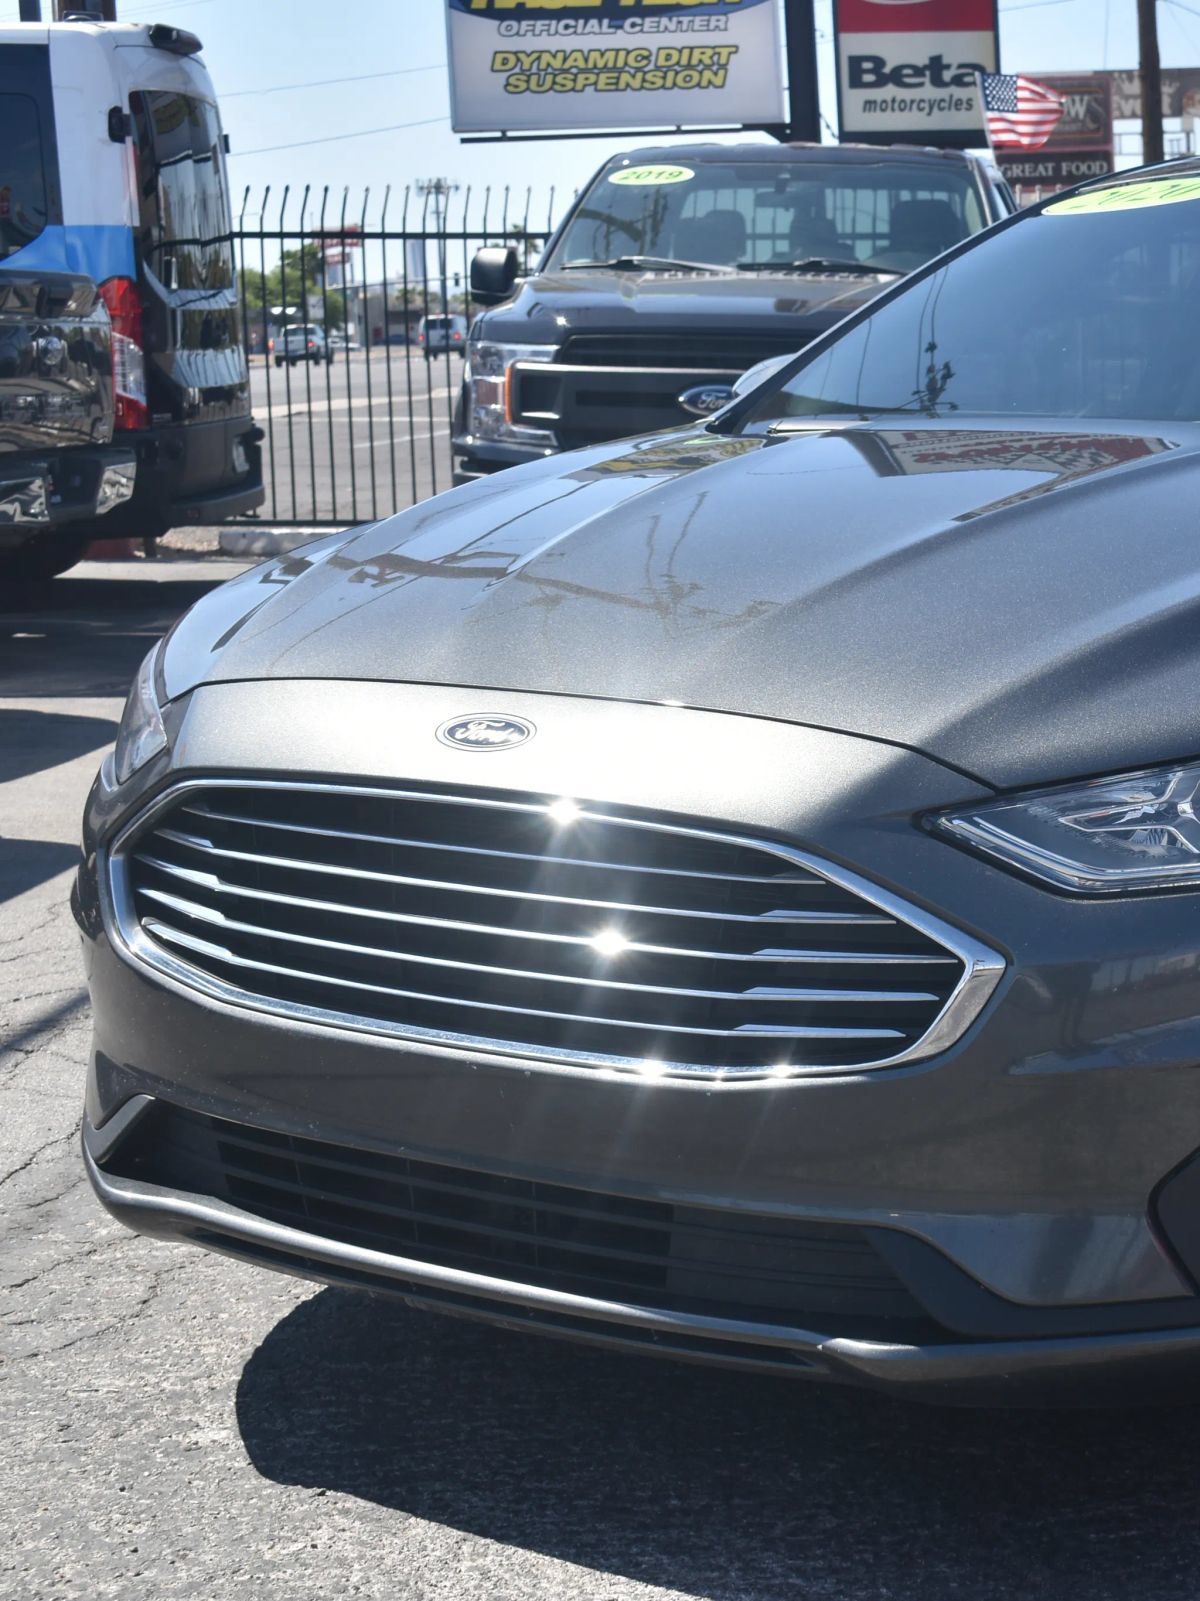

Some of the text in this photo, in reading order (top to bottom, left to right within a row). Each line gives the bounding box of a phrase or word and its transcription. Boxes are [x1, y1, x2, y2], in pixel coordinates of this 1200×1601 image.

[498, 15, 729, 37] OFFICIAL CENTER
[491, 45, 738, 73] DYNAMIC DIRT
[504, 68, 728, 94] SUSPENSION
[847, 54, 986, 89] Beta
[862, 92, 974, 116] motorcycles
[618, 170, 684, 181] 2019
[1001, 160, 1108, 178] GREAT FOOD
